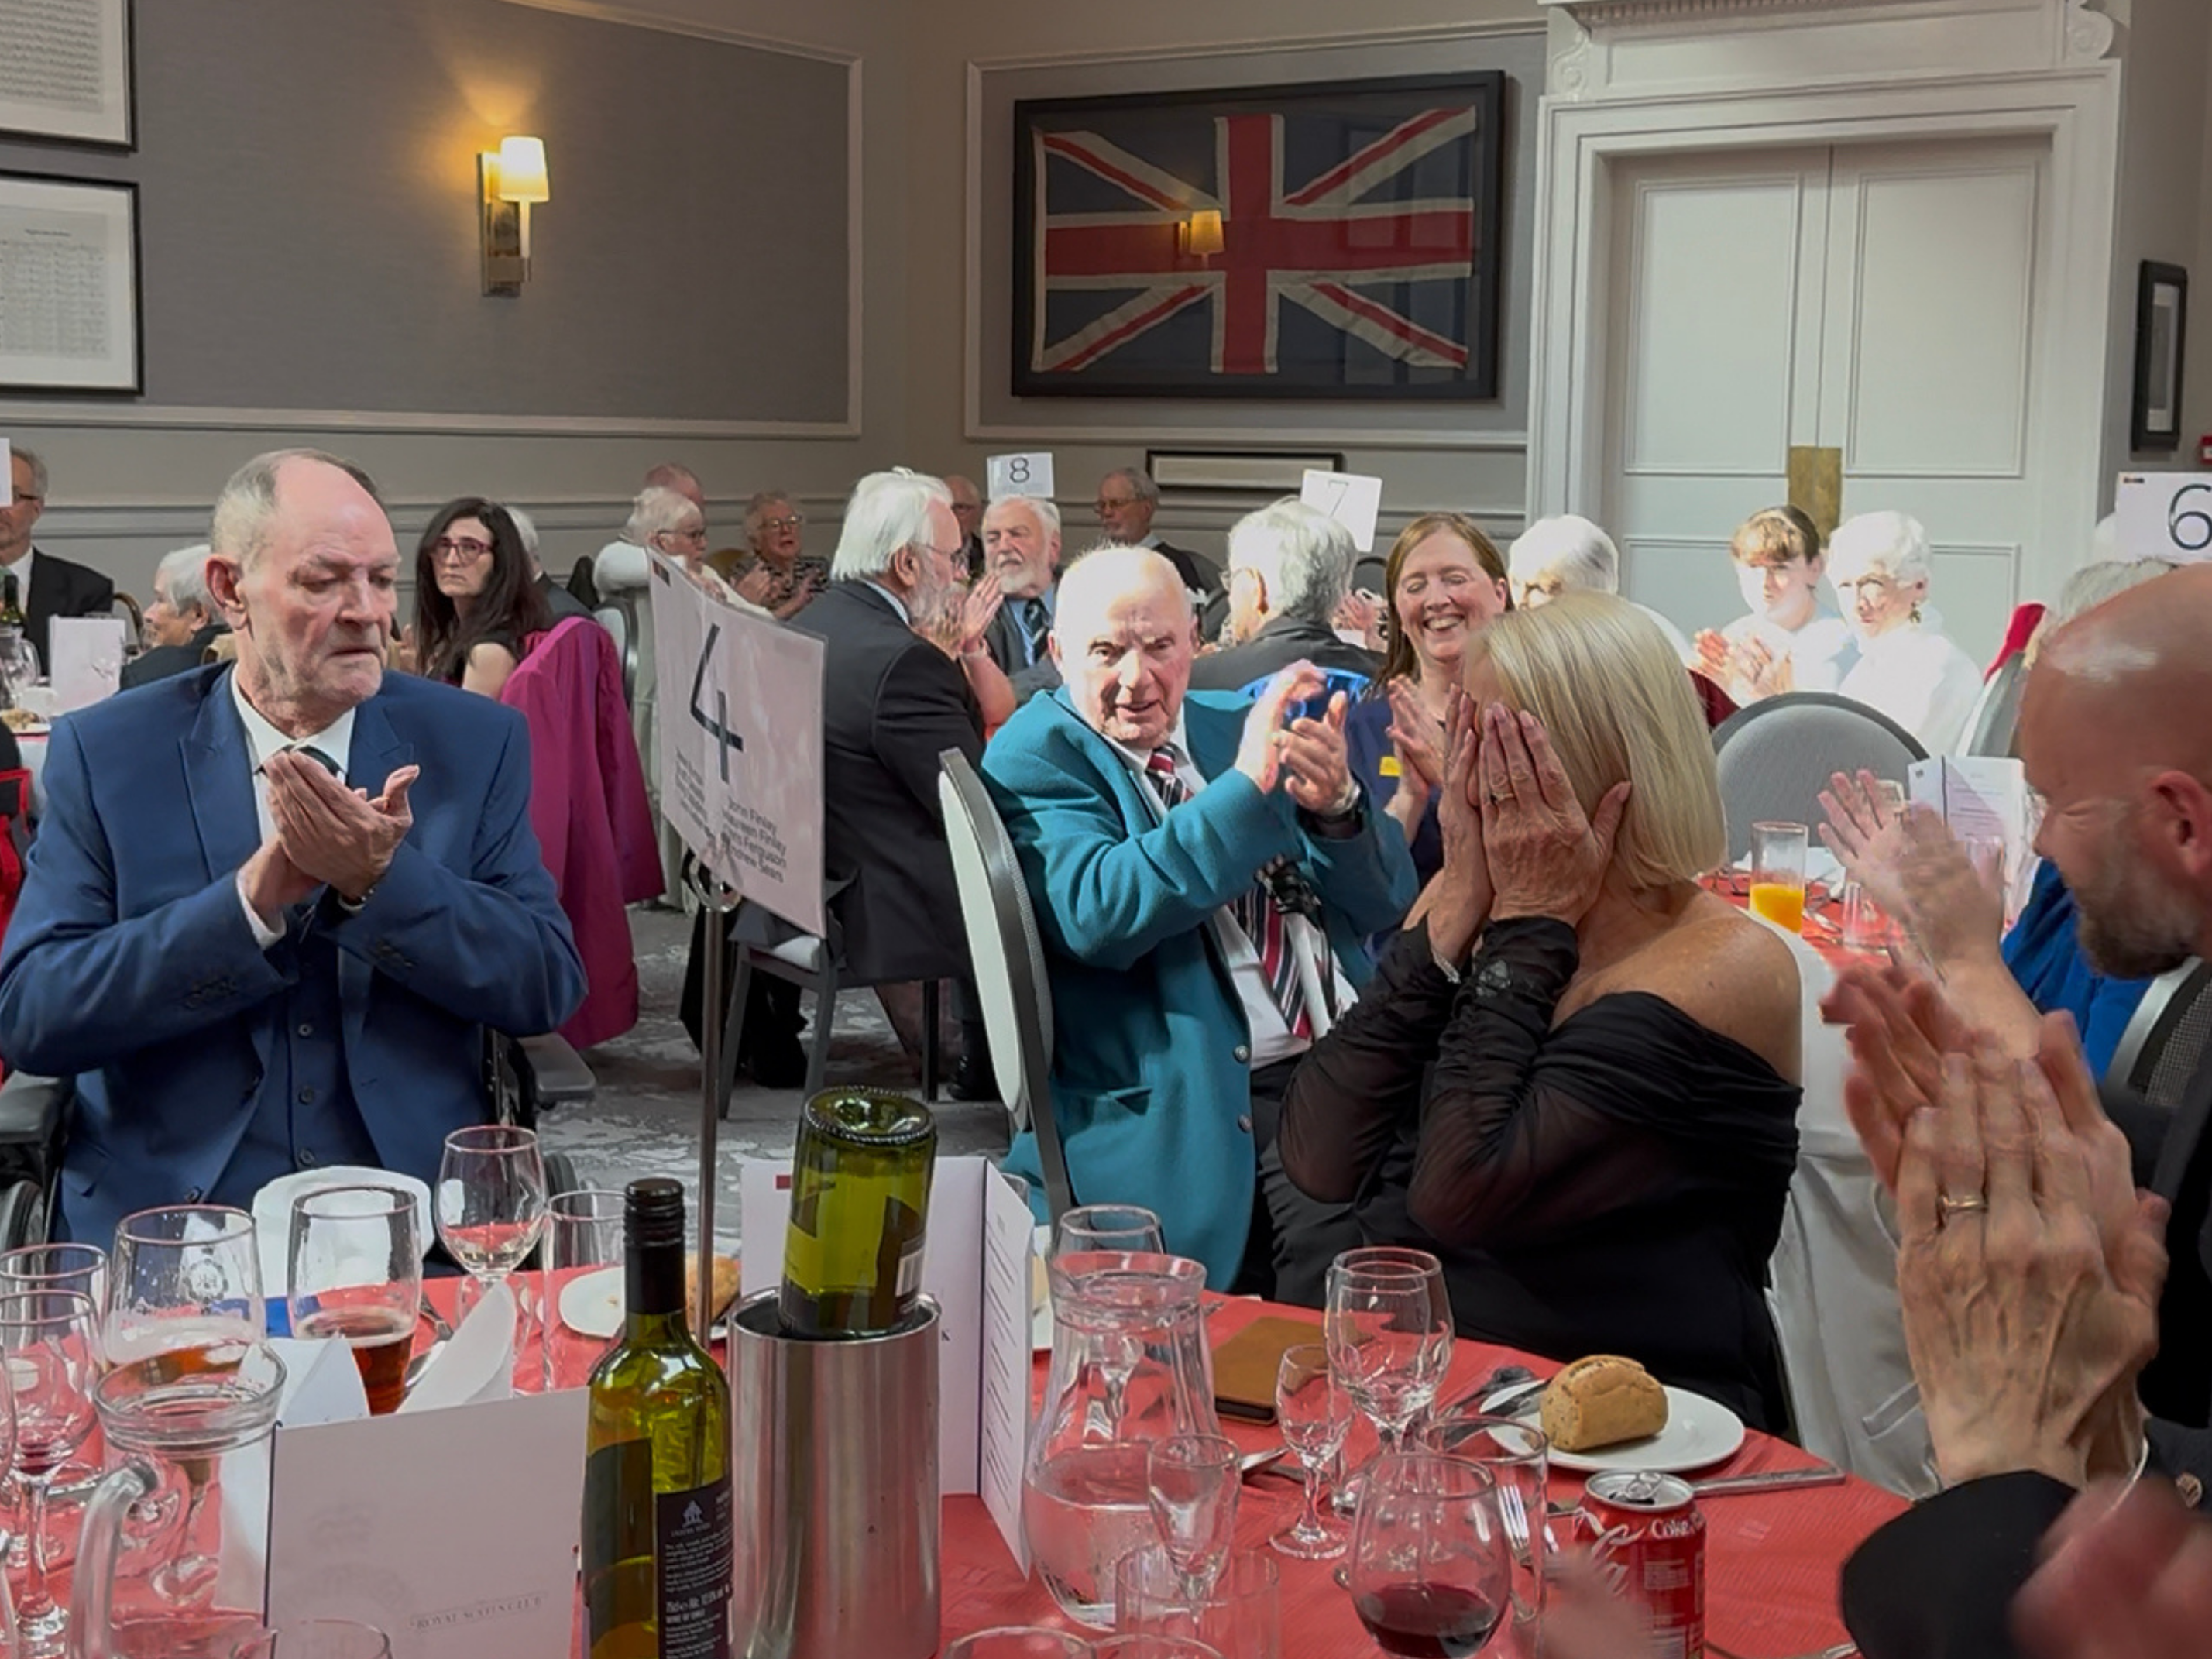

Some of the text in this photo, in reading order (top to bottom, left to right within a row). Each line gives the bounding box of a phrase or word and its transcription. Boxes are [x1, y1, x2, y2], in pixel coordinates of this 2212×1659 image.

[1009, 457, 1029, 483] 8
[1328, 480, 1348, 519] 7
[2169, 484, 2212, 551] 6
[690, 623, 744, 785] 4
